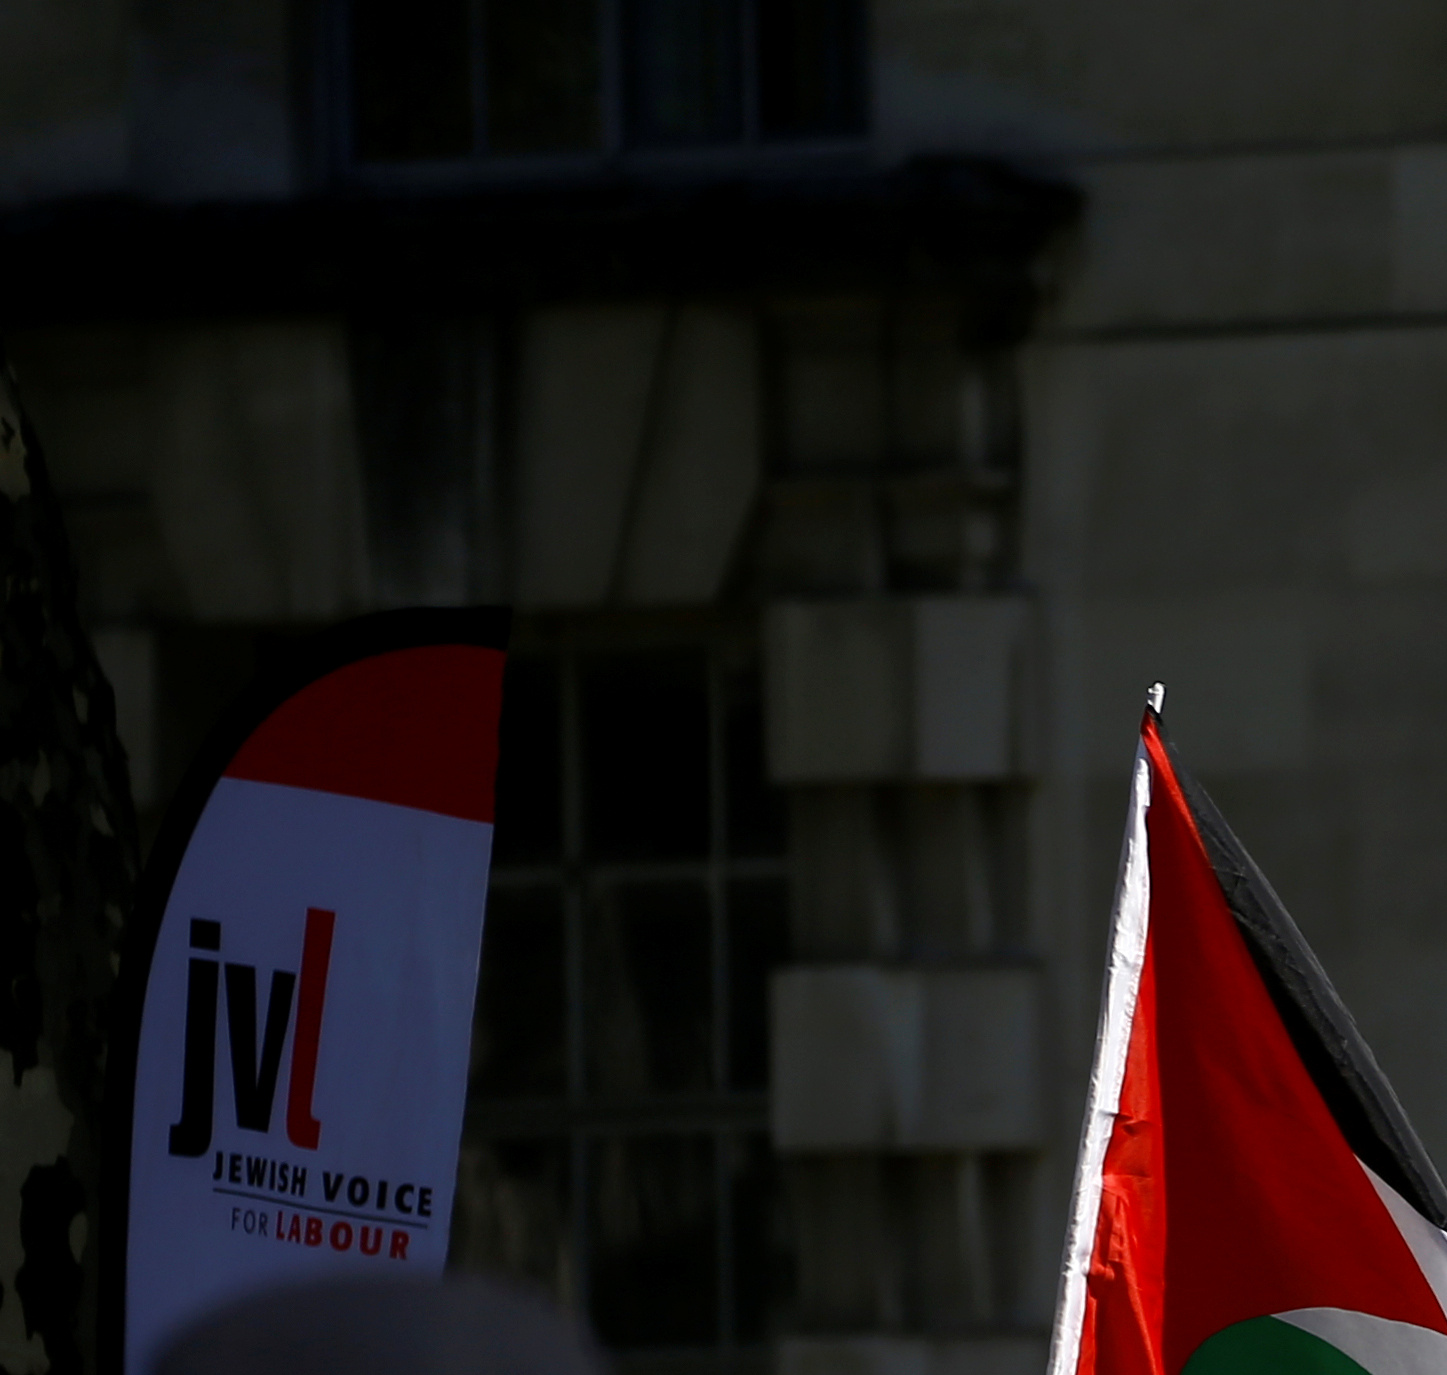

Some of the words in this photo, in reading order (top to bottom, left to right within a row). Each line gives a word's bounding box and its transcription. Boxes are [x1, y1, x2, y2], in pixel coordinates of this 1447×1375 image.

[168, 907, 335, 1156] jvl
[213, 1151, 307, 1197] JEWISH
[322, 1171, 433, 1217] VOICE
[231, 1207, 269, 1237] FOR
[275, 1211, 409, 1260] LABOUR
